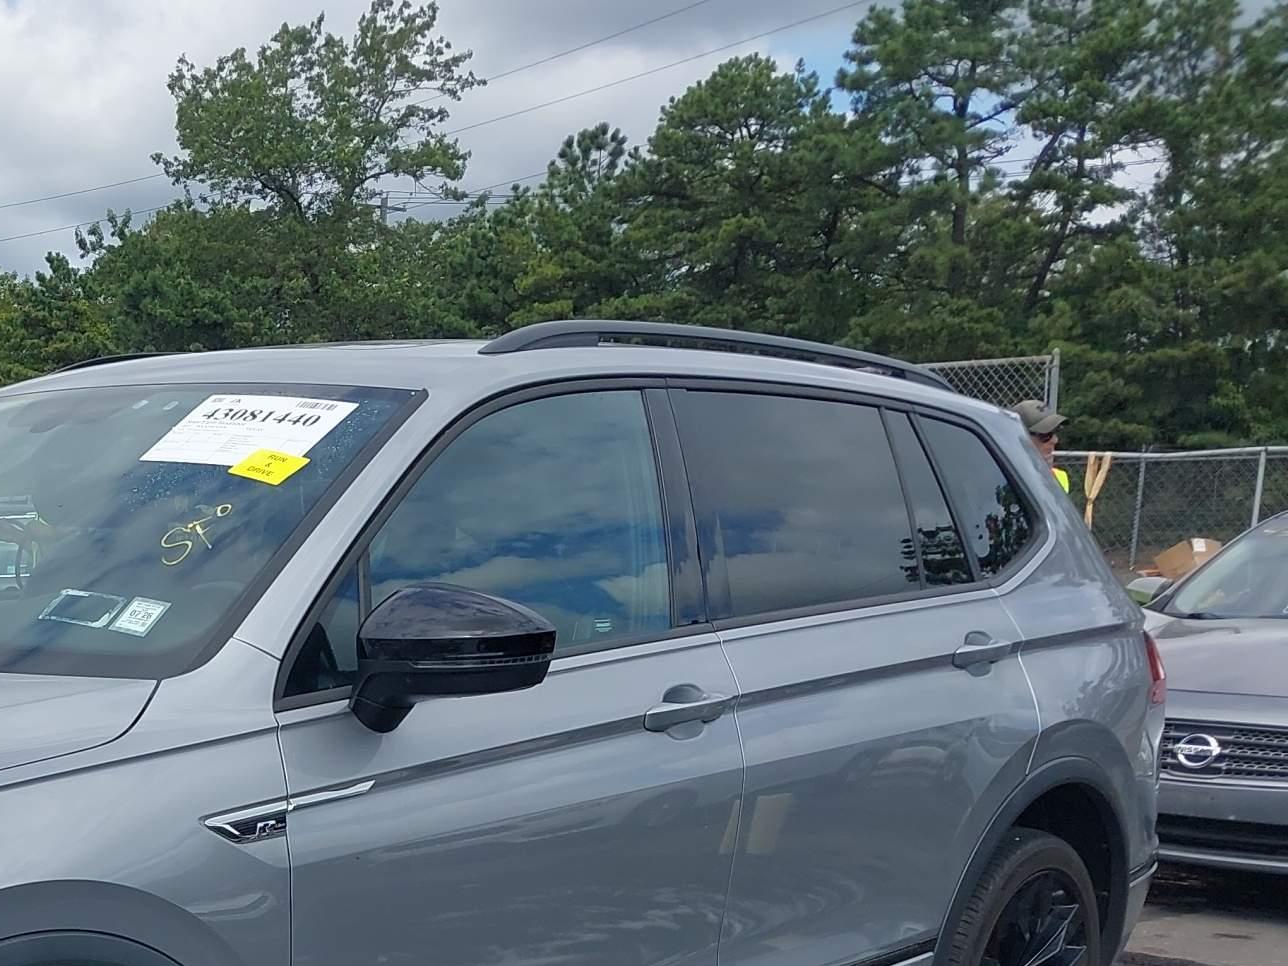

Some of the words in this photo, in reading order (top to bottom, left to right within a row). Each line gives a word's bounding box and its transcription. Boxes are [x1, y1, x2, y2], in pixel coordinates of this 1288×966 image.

[202, 407, 321, 428] 43081440
[267, 454, 289, 463] RUN
[247, 465, 275, 477] DRIVE
